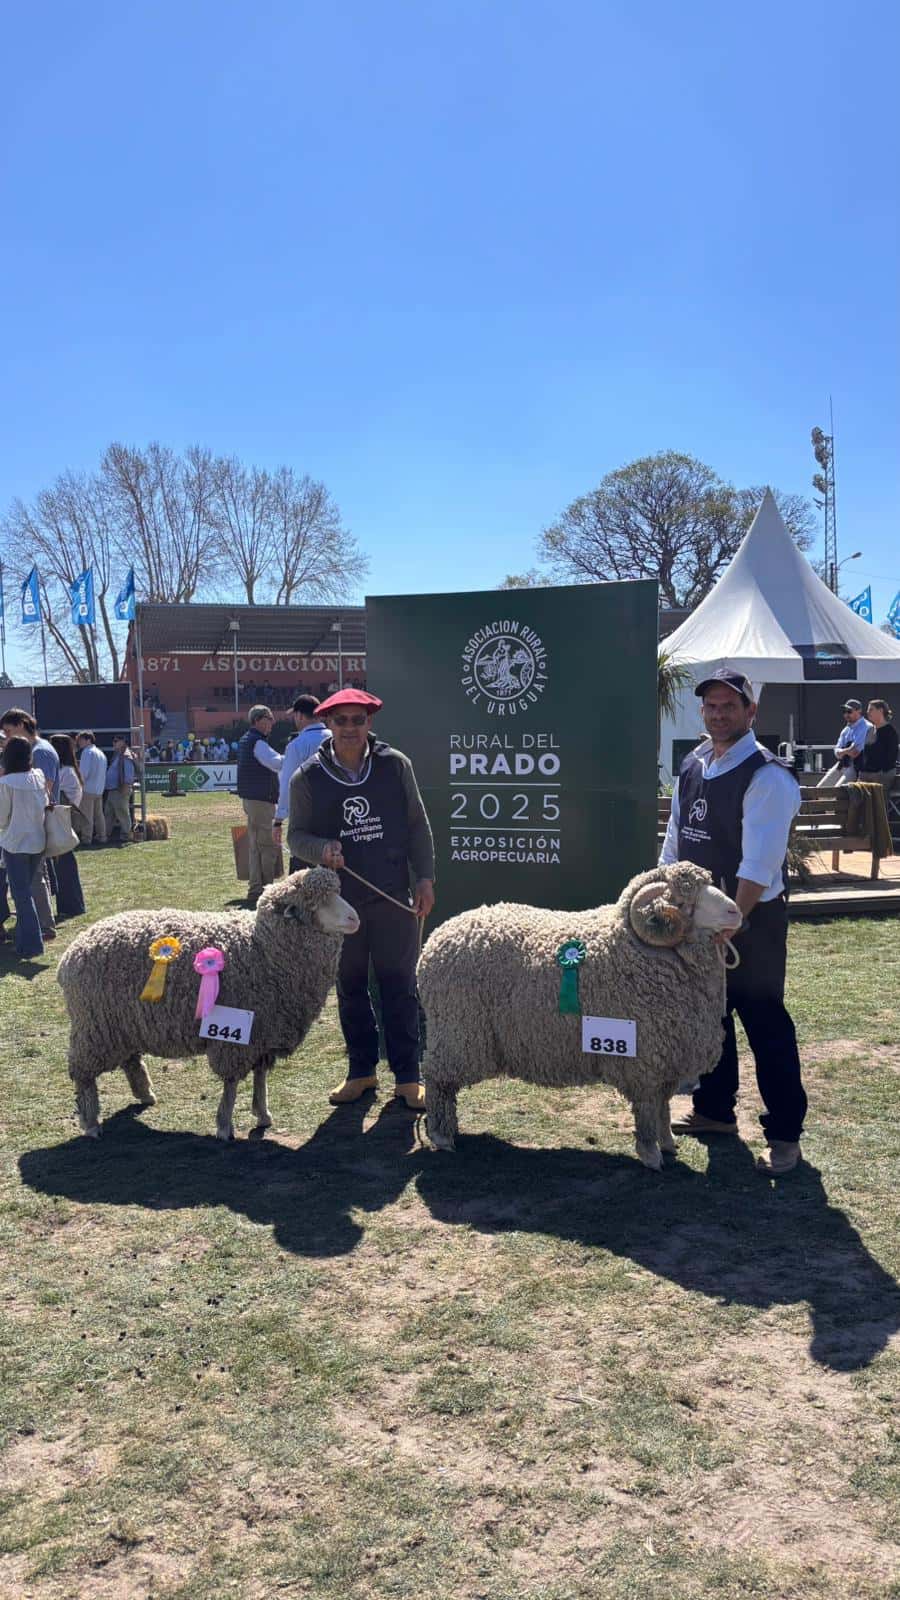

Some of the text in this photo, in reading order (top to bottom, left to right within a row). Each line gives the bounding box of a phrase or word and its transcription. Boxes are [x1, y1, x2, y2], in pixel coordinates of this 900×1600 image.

[462, 620, 548, 663] ASOCIACION RURAL
[201, 657, 339, 672] ASOCIACION
[461, 672, 549, 716] DEL URUGUAY
[450, 733, 560, 749] RURAL DEL
[449, 753, 561, 775] PRADO
[450, 793, 560, 820] 2025
[355, 816, 381, 826] Merino
[353, 832, 384, 842] Uruguay
[451, 835, 560, 850] EXPOSICIÓN
[451, 850, 560, 864] AGROPECUARIA
[207, 1023, 242, 1041] 844
[590, 1037, 628, 1054] 838
